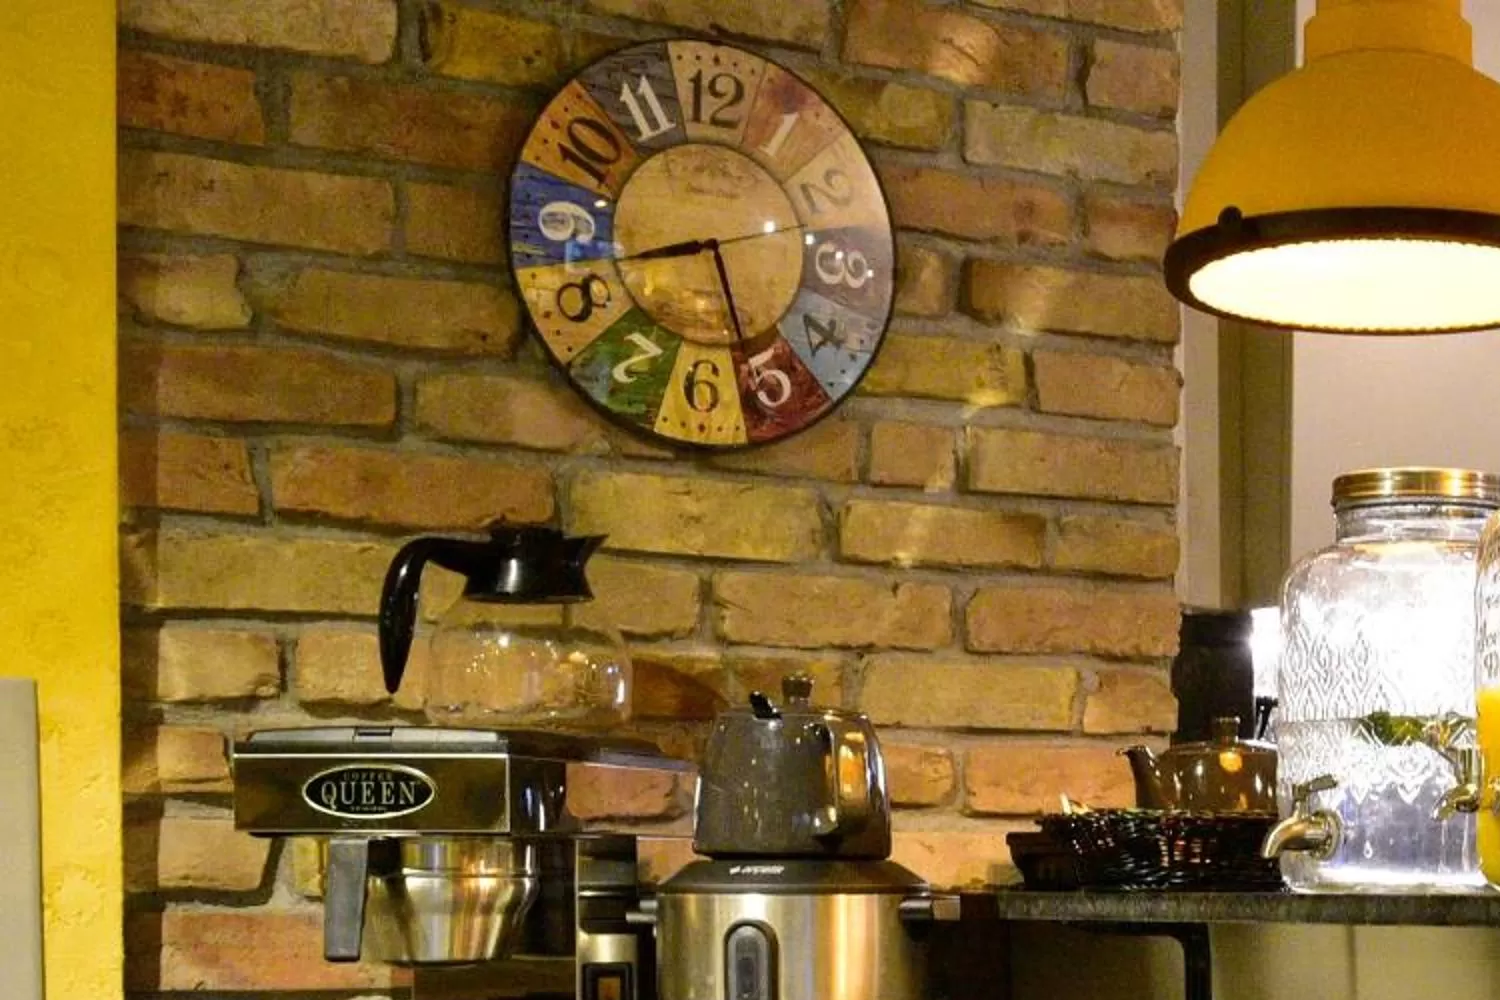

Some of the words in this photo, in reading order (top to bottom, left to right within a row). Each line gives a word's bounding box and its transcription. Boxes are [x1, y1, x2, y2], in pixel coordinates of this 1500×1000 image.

[619, 74, 676, 144] 11
[687, 68, 745, 127] 12
[556, 116, 623, 199] 10
[758, 112, 801, 158] 1
[799, 167, 855, 214] 2
[536, 200, 596, 244] 9
[814, 242, 869, 289] 3
[555, 273, 612, 324] 8
[612, 331, 663, 383] 7
[802, 312, 848, 356] 4
[682, 359, 719, 413] 6
[746, 349, 792, 407] 5
[321, 781, 417, 810] QUEEN
